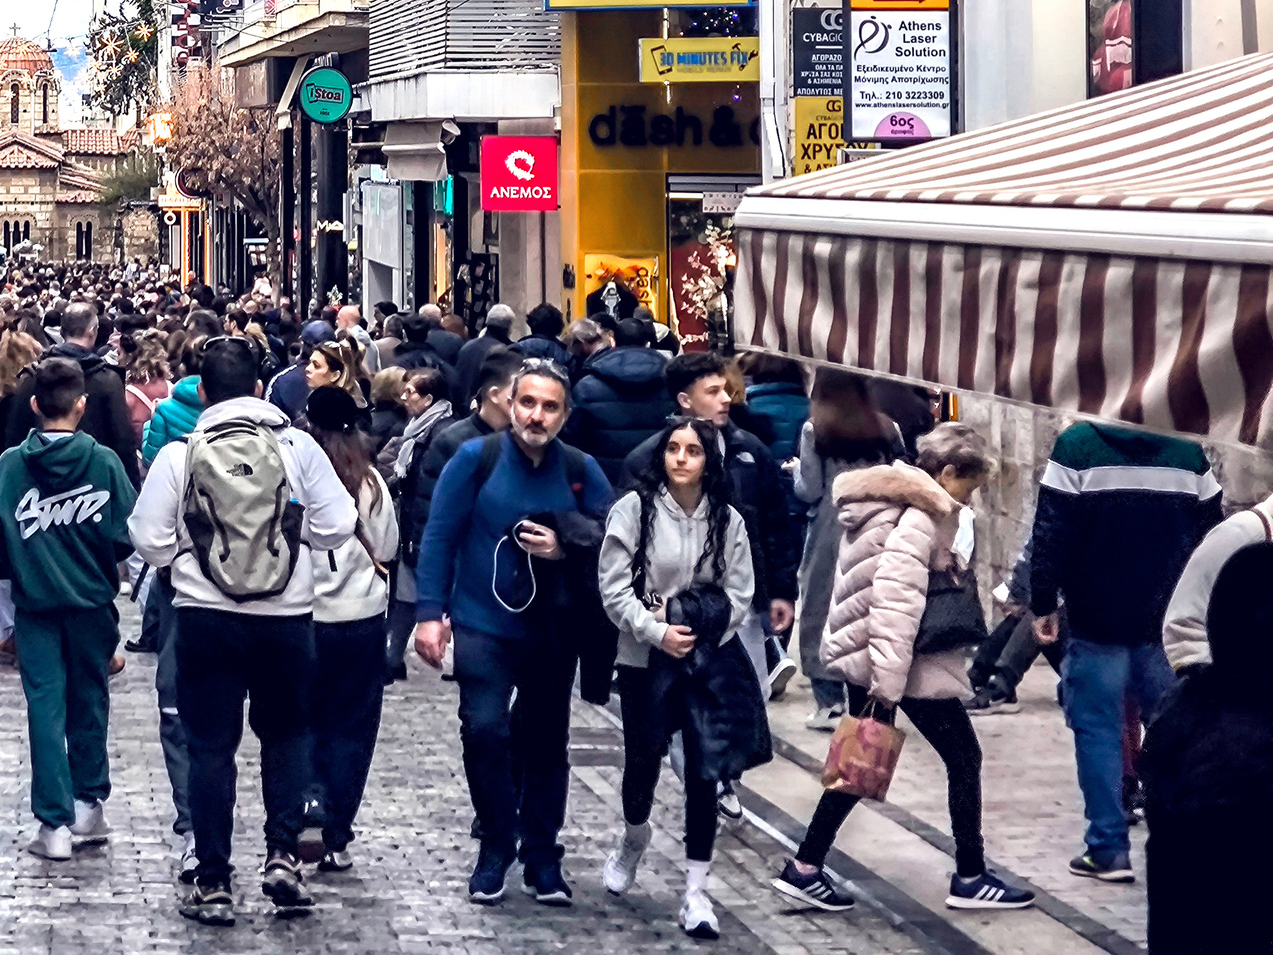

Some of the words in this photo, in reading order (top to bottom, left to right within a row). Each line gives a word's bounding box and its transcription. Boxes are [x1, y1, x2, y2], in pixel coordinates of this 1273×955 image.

[898, 20, 942, 32] Athens
[902, 33, 937, 45] Laser
[895, 46, 946, 58] Solution
[677, 52, 728, 66] MINUTES
[731, 51, 748, 65] FIX
[856, 64, 915, 74] Εξειδικευμένο
[916, 64, 947, 74] Κέντρο
[854, 76, 889, 85] Μόνιμης
[891, 76, 949, 85] Αποτρίχωσης
[886, 91, 903, 100] 210
[905, 91, 945, 100] 3223309
[890, 114, 915, 129] 6ος
[490, 186, 552, 199] ΑΝΕΜΟΣ
